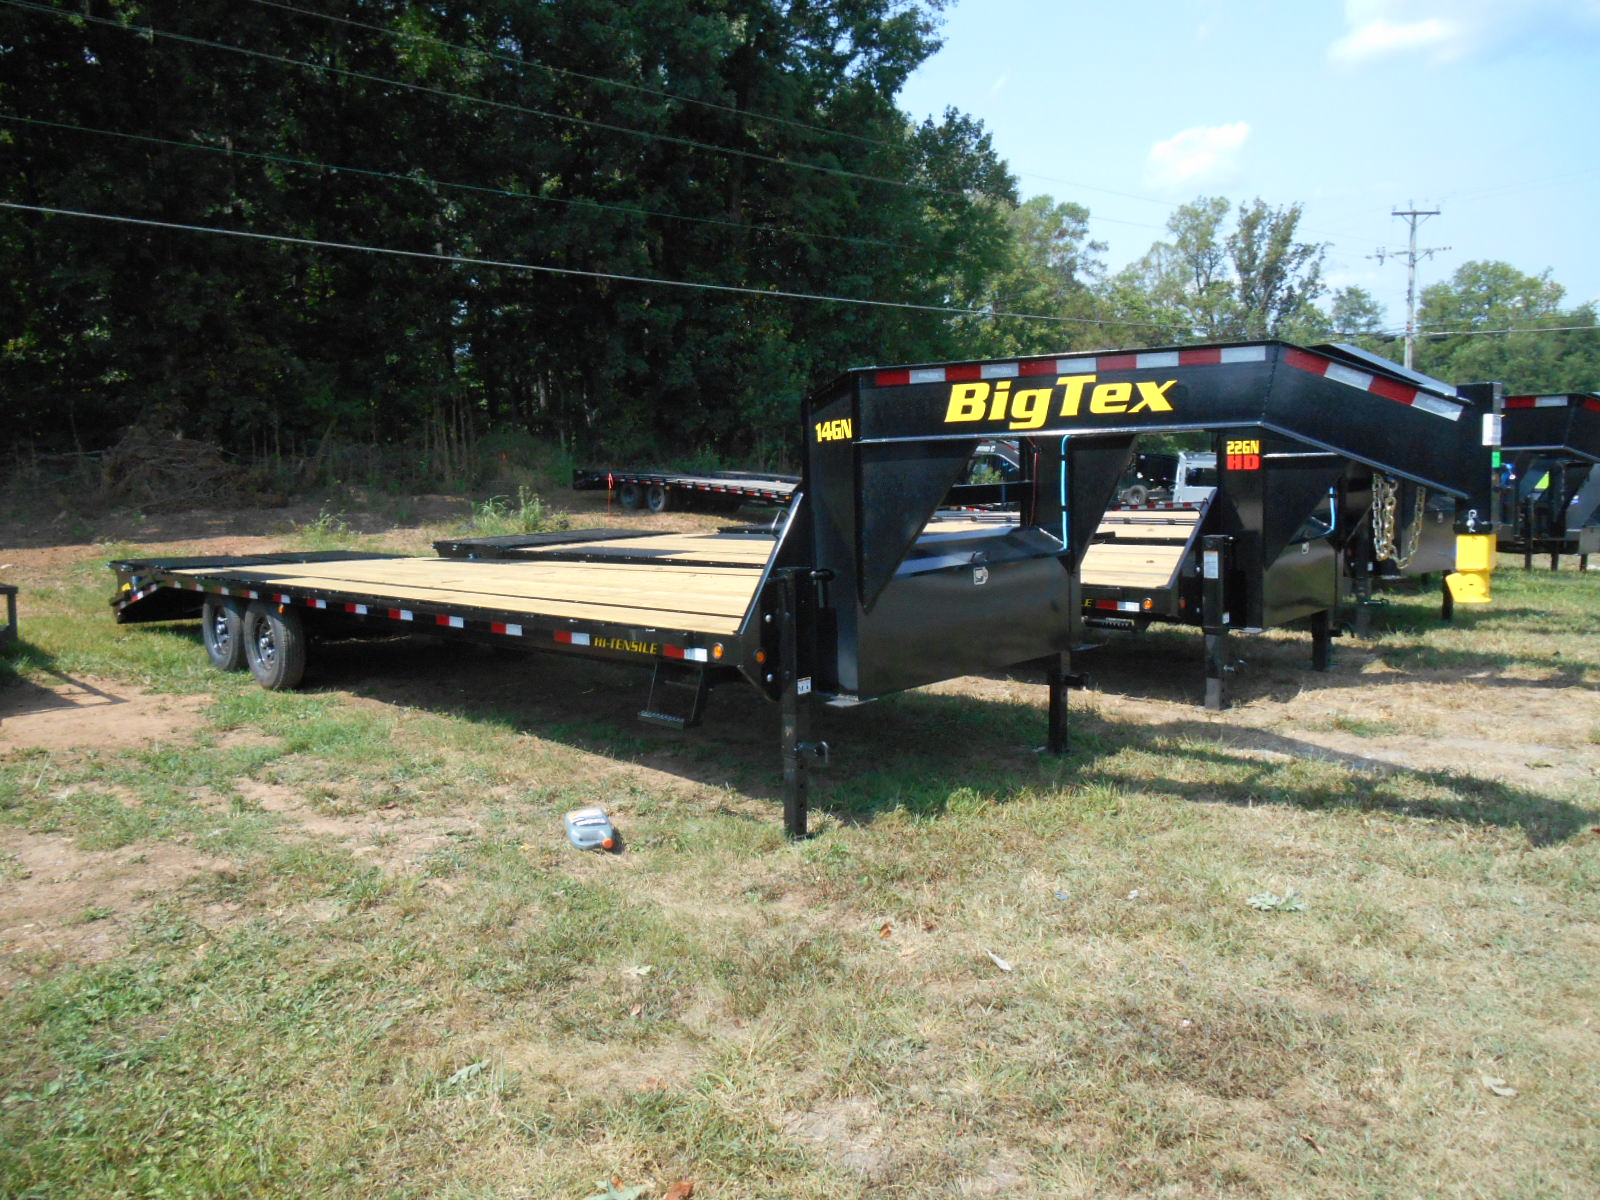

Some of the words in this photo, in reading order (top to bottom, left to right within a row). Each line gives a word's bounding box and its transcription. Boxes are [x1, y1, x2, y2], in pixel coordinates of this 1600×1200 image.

[944, 374, 1178, 430] BigTex
[1226, 455, 1261, 470] HD
[594, 637, 658, 655] HI-TENSILE
